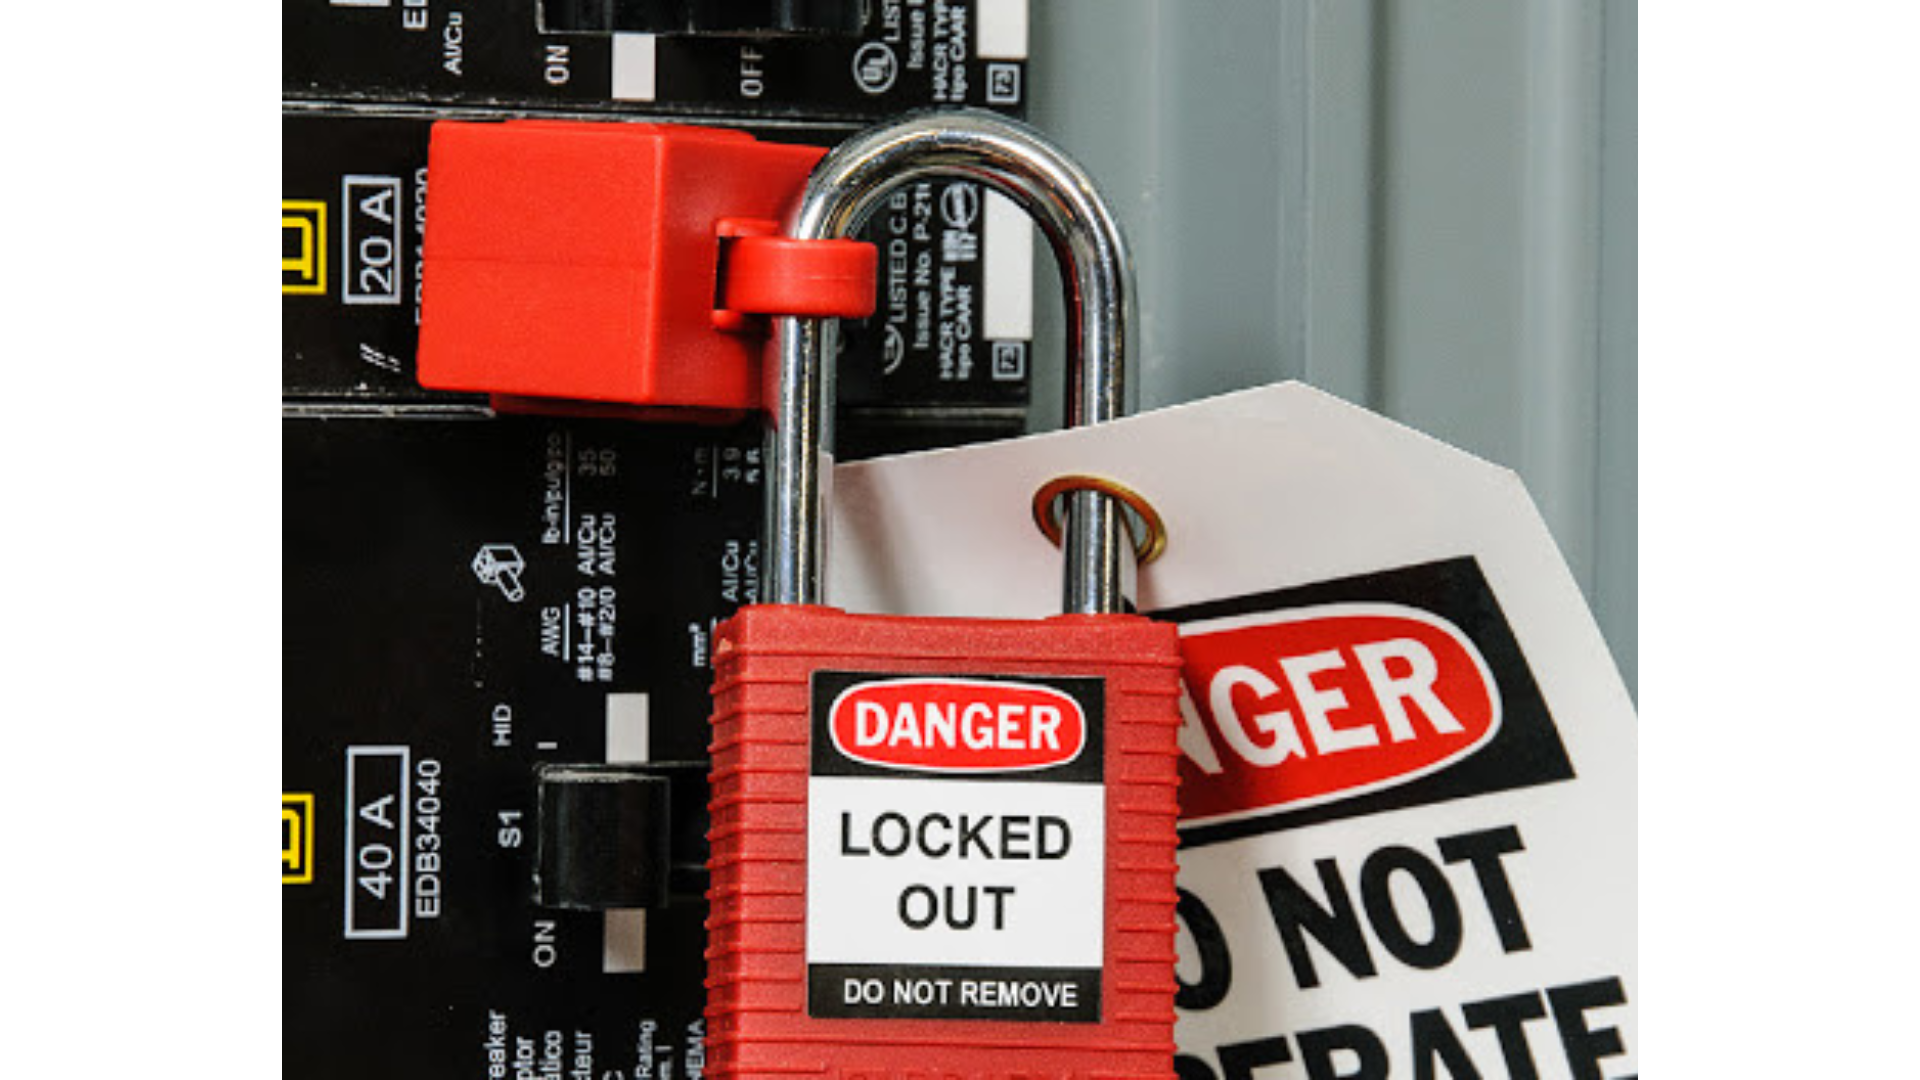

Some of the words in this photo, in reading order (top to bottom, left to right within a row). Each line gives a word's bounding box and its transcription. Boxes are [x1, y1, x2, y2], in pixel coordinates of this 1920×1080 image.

[545, 45, 569, 84] ON
[906, 11, 924, 69] Issue
[741, 46, 763, 97] OFF
[933, 43, 949, 101] HACR
[360, 188, 392, 225] A
[360, 236, 392, 294] 20
[890, 238, 908, 323] LISTED
[913, 248, 931, 286] No.
[940, 266, 956, 319] TYPE
[912, 290, 931, 349] Issue
[940, 323, 955, 379] HACR
[579, 449, 597, 476] 35
[577, 513, 596, 576] Al/Cu
[599, 513, 616, 576] Al/Cu
[722, 540, 739, 602] Al/Cu
[541, 606, 561, 657] AWG
[493, 703, 512, 746] HID
[853, 700, 1062, 751] DANGER
[359, 794, 395, 829] A
[499, 809, 521, 848] S1
[841, 811, 1072, 860] LOCKED
[416, 759, 441, 918] EDB34040
[359, 843, 394, 899] 40
[898, 884, 1015, 931] OUT
[1256, 824, 1533, 990] NOT
[533, 920, 556, 968] ON
[843, 979, 885, 1005] DO
[893, 979, 953, 1006] NOT
[960, 981, 1078, 1008] REMOVE
[483, 1010, 506, 1080] eaker
